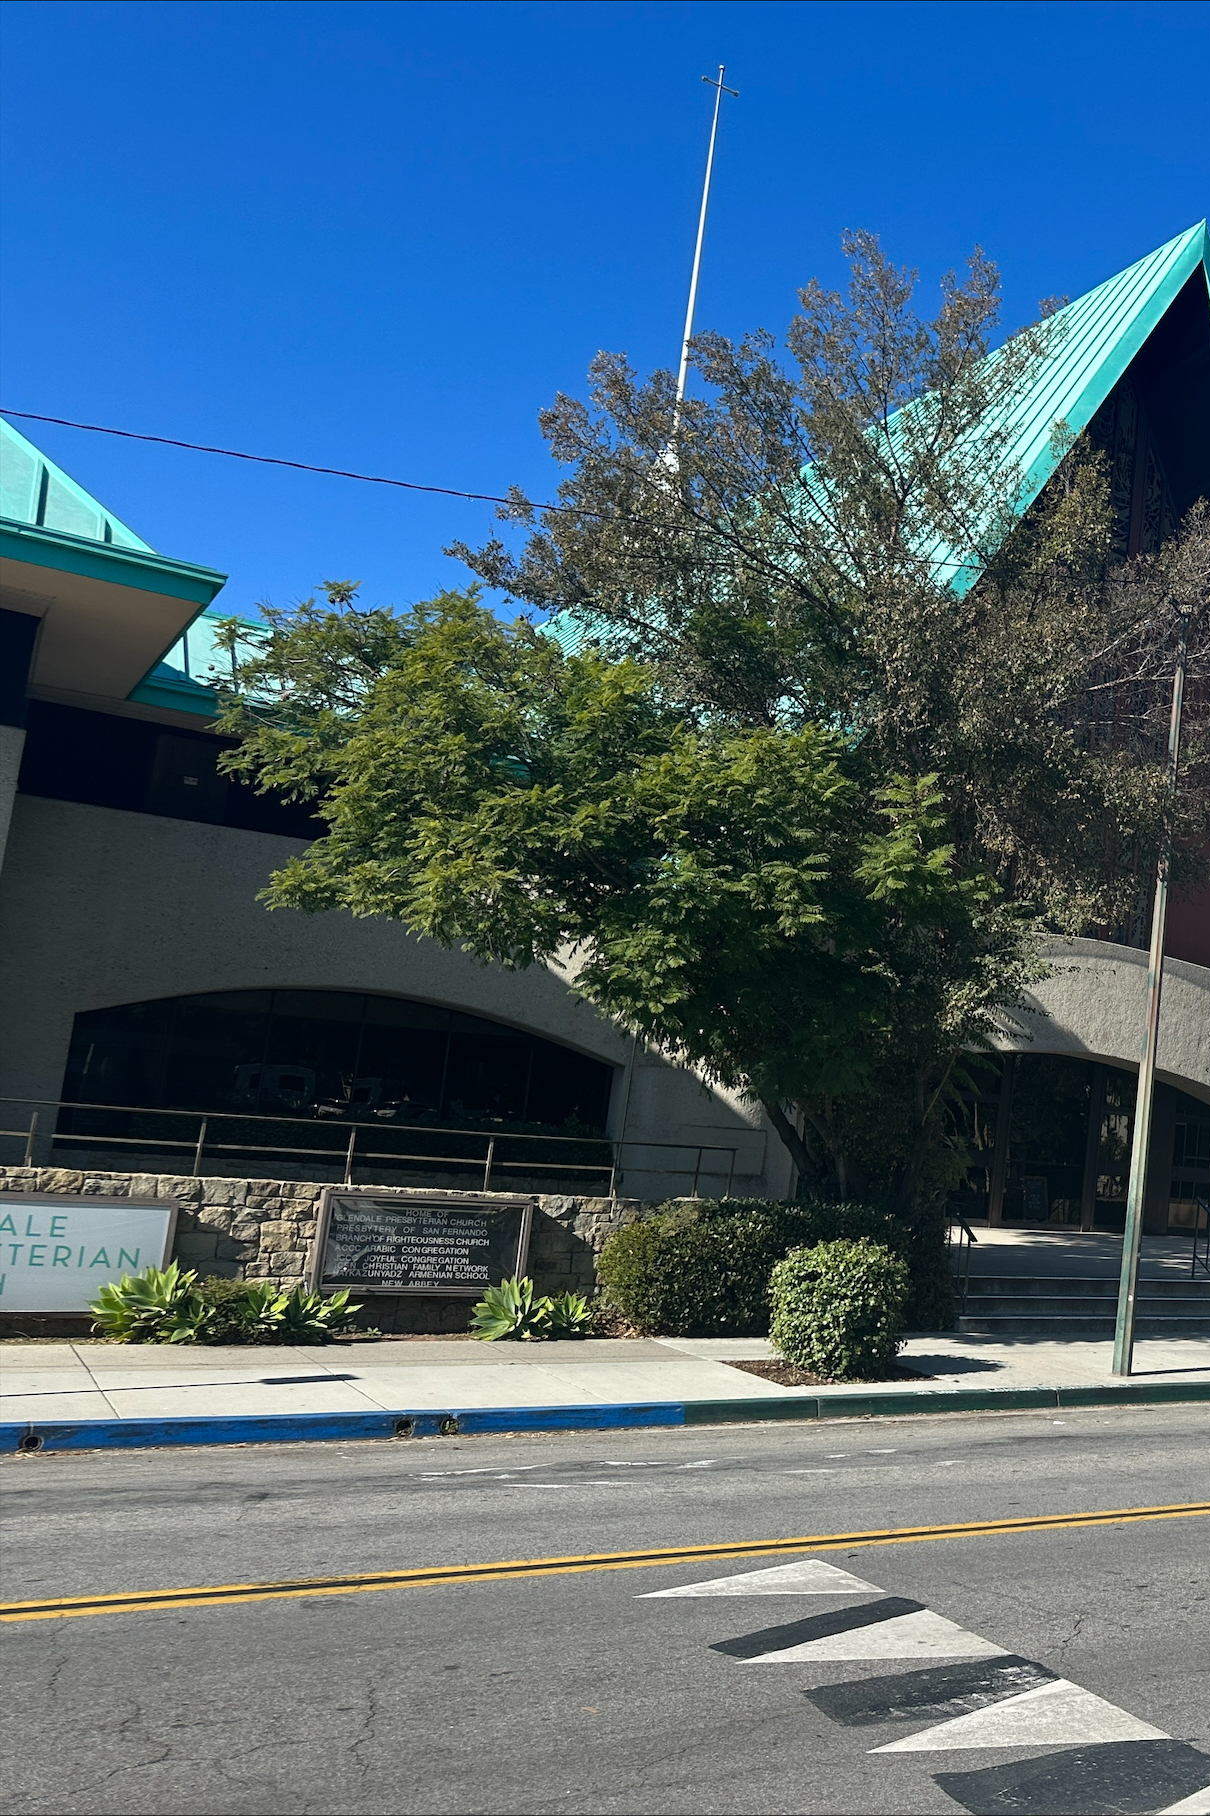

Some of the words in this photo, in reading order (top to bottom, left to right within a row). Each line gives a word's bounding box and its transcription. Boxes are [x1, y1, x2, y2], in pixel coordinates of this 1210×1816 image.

[405, 1209, 432, 1218] HOME
[385, 1215, 448, 1225] PRESBYTERIAN
[450, 1218, 487, 1227] CHURCH
[336, 1224, 397, 1233] PRESBYTERY
[403, 1226, 416, 1234] OF
[422, 1227, 440, 1235] SAN
[442, 1228, 488, 1237] FERNANDO
[336, 1233, 371, 1242] BRANCH
[386, 1235, 455, 1245] RIGHTEOUSNESS
[456, 1238, 489, 1246] CHURCH
[364, 1245, 396, 1253] ARABIC
[0, 1243, 140, 1269] TERIAN
[364, 1255, 397, 1263] JOYFUL
[401, 1256, 469, 1265] CONGREGATION
[362, 1263, 408, 1271] CHRISTIAN
[445, 1265, 489, 1273] NETWORK
[408, 1271, 453, 1279] ARMENIAN
[455, 1272, 490, 1280] SCHOOL
